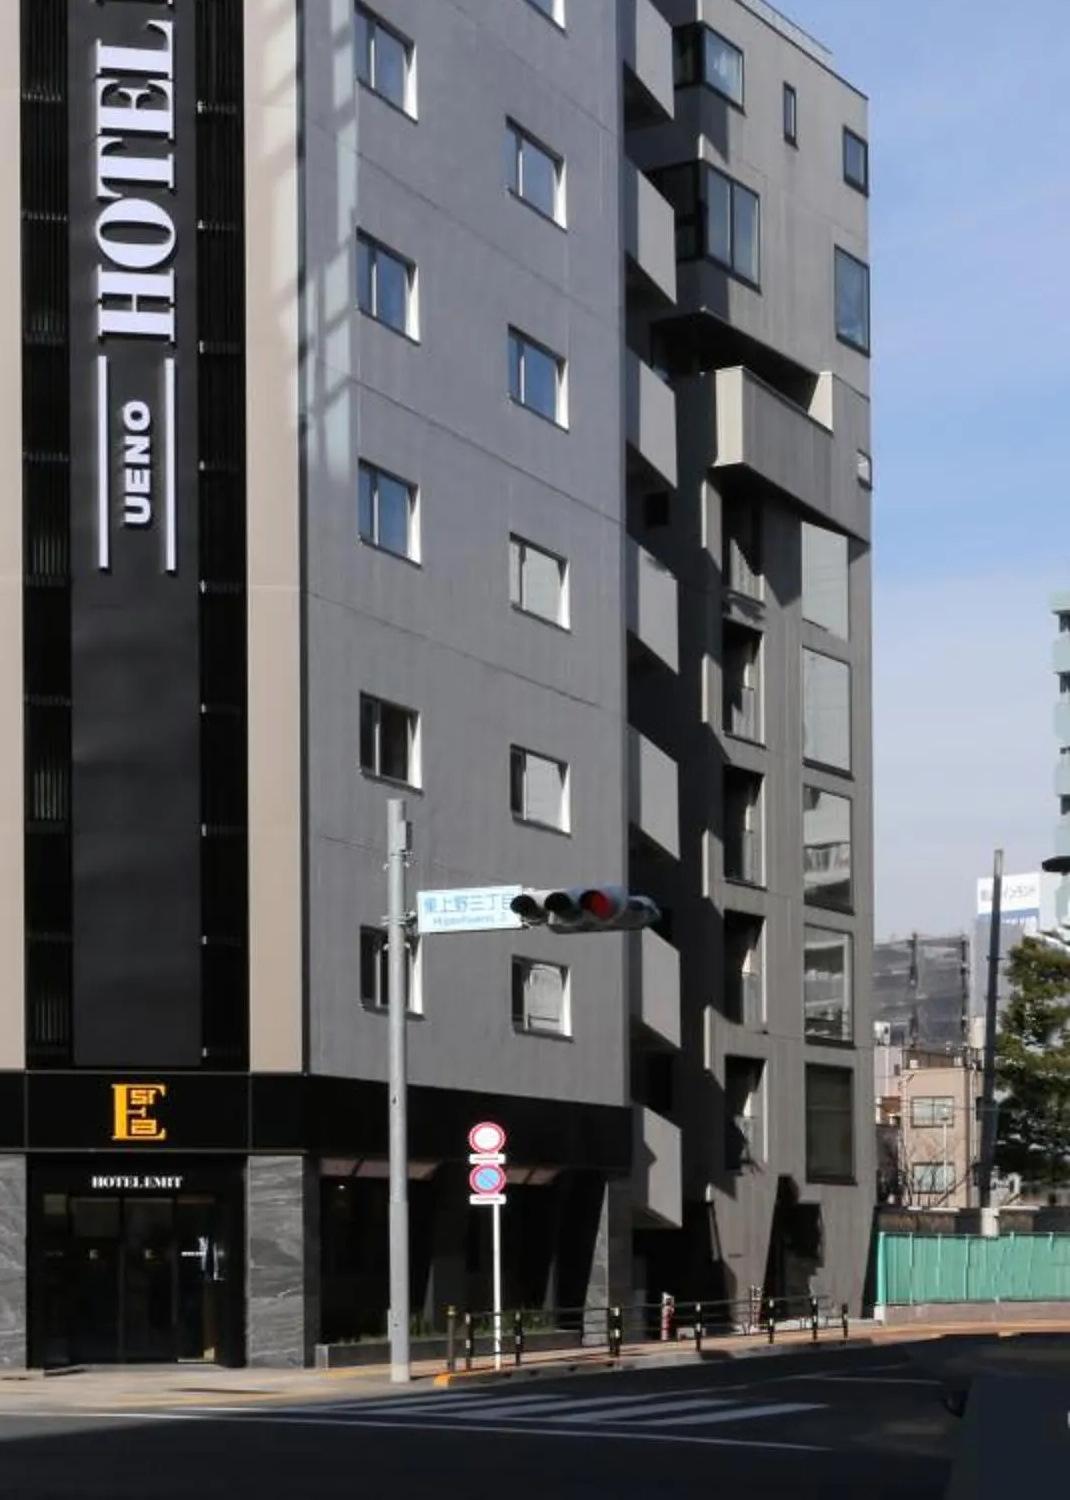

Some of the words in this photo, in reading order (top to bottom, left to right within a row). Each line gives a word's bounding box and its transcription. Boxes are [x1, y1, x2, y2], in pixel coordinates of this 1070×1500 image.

[95, 19, 177, 343] HOTEL
[123, 398, 151, 527] UENO
[91, 1175, 143, 1189] HOTEL
